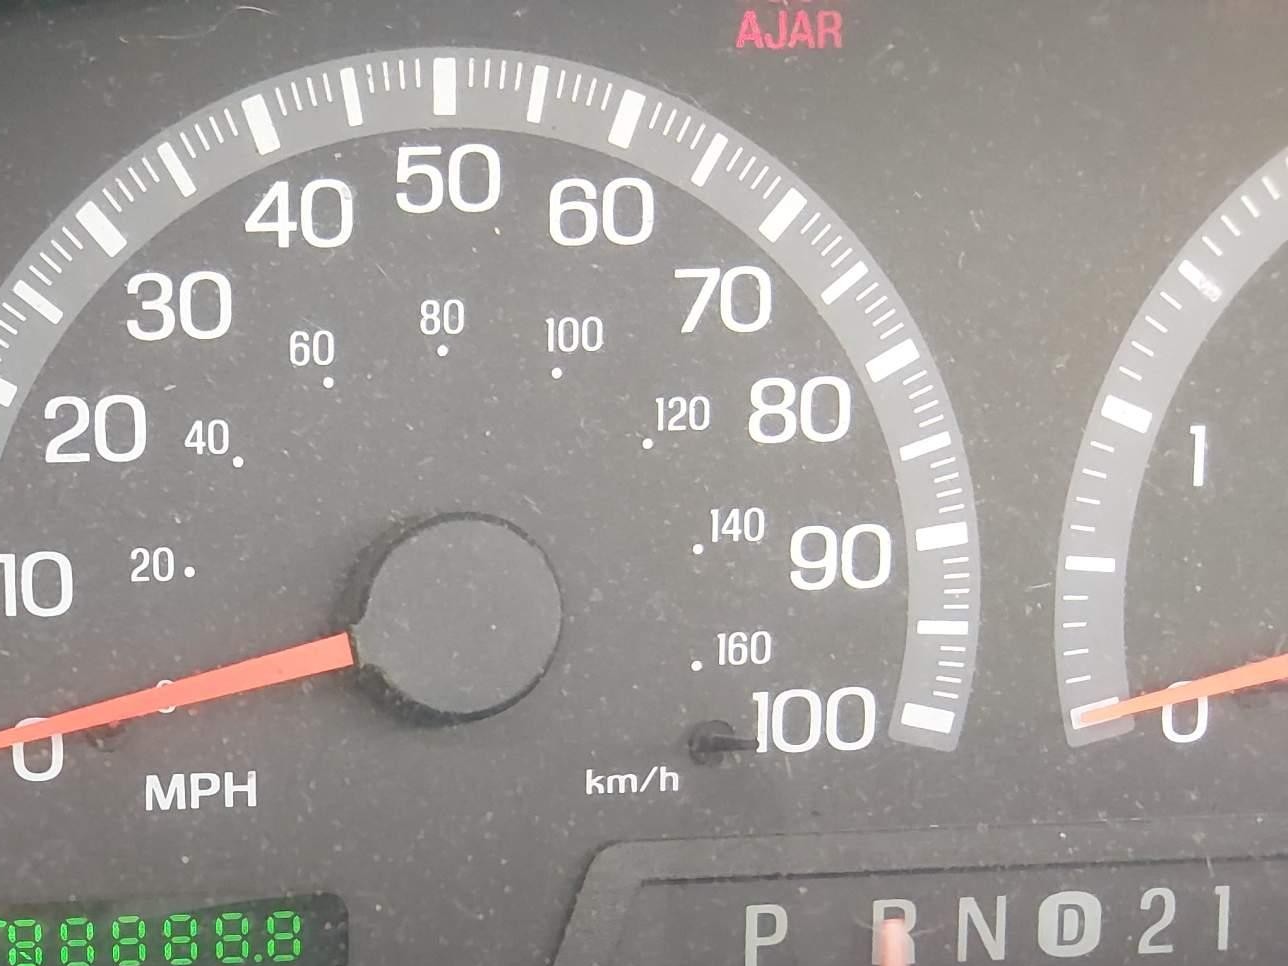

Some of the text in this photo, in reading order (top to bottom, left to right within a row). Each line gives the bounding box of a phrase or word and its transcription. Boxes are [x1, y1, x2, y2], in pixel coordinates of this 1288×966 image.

[736, 10, 843, 49] AJAR
[396, 144, 501, 214] 50
[244, 178, 354, 248] 40
[549, 177, 655, 246] 60
[126, 271, 232, 341] 30
[419, 299, 465, 335] 80
[674, 266, 772, 333] 70
[289, 330, 335, 366] 60
[545, 316, 604, 353] 100
[44, 395, 147, 463] 20
[184, 420, 230, 455] 40
[655, 396, 711, 431] 120
[748, 376, 852, 444] 80
[1189, 425, 1208, 487] 1
[710, 508, 765, 543] 140
[130, 547, 175, 582] 20
[790, 524, 892, 591] 90
[717, 631, 772, 666] 160
[752, 686, 876, 753] 100
[1161, 680, 1209, 744] 0
[12, 717, 64, 782] 0
[144, 771, 258, 811] MPH
[585, 767, 679, 796] km/h
[957, 896, 1007, 962] N
[1138, 888, 1176, 954] 2
